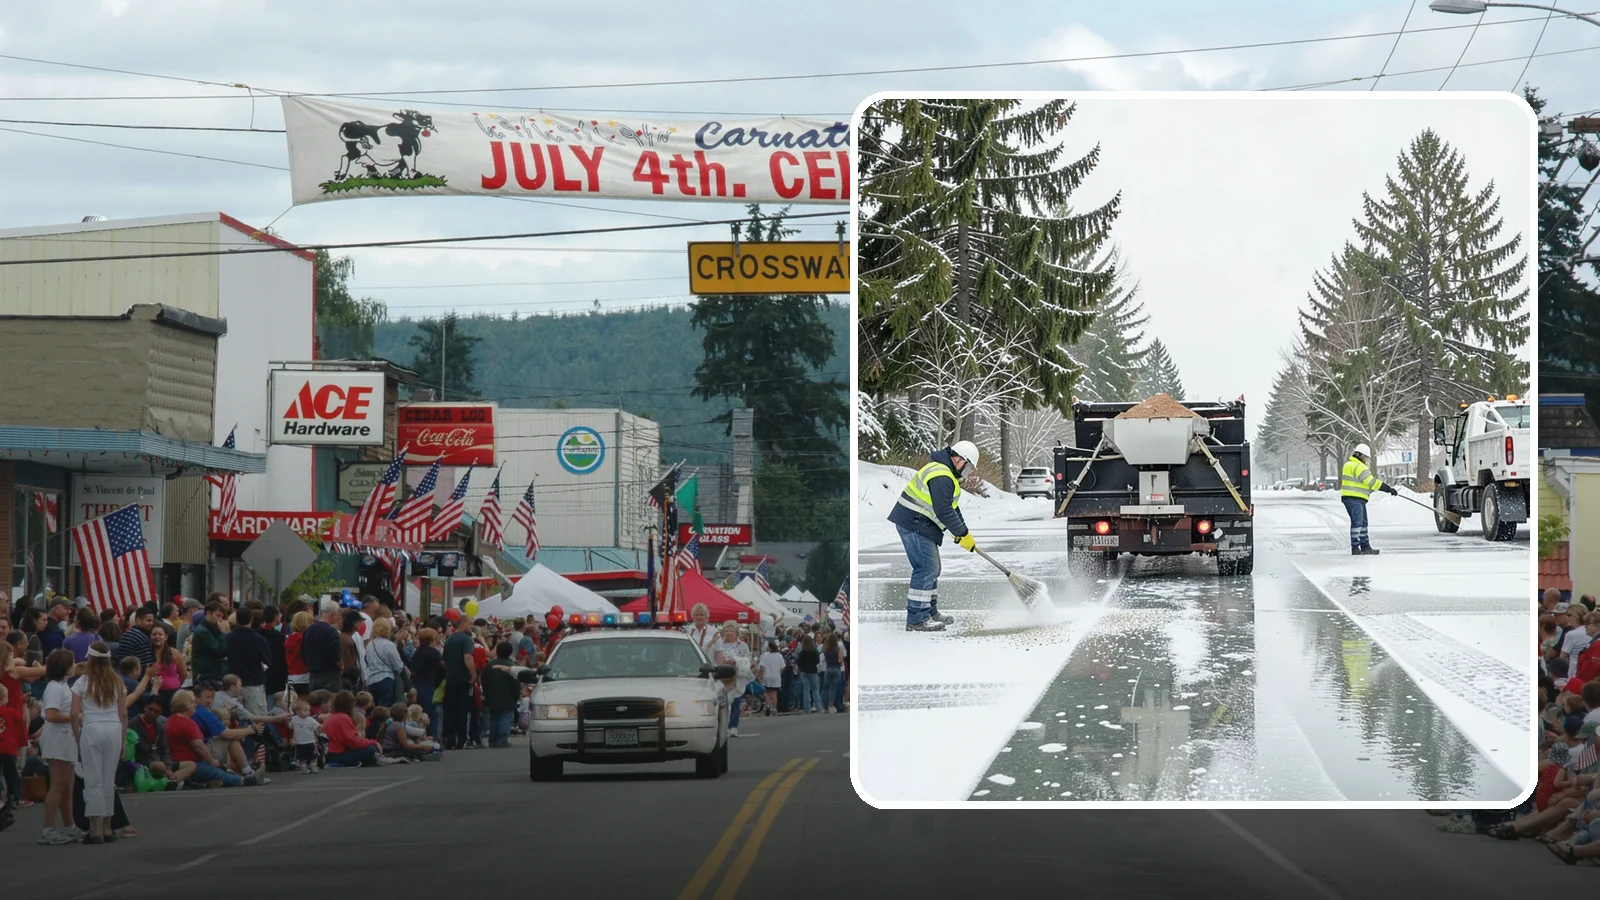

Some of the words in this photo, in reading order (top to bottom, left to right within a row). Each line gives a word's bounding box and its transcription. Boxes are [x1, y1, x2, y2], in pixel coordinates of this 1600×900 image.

[694, 121, 850, 150] Carnat
[481, 140, 605, 192] JULY
[632, 150, 746, 198] 4th.
[696, 253, 850, 280] CROSSWA
[282, 379, 374, 420] ACE
[405, 409, 453, 422] CEDAR
[461, 409, 485, 422] LOG
[283, 421, 371, 437] Hardware
[416, 428, 477, 447] Coca-Cola
[353, 467, 386, 480] Simpl
[83, 484, 94, 495] St.
[95, 485, 124, 495] Vincent
[126, 485, 136, 495] de
[137, 485, 155, 496] Paul
[80, 503, 154, 522] THT
[687, 526, 742, 535] CRNATION
[698, 535, 730, 544] GLASS
